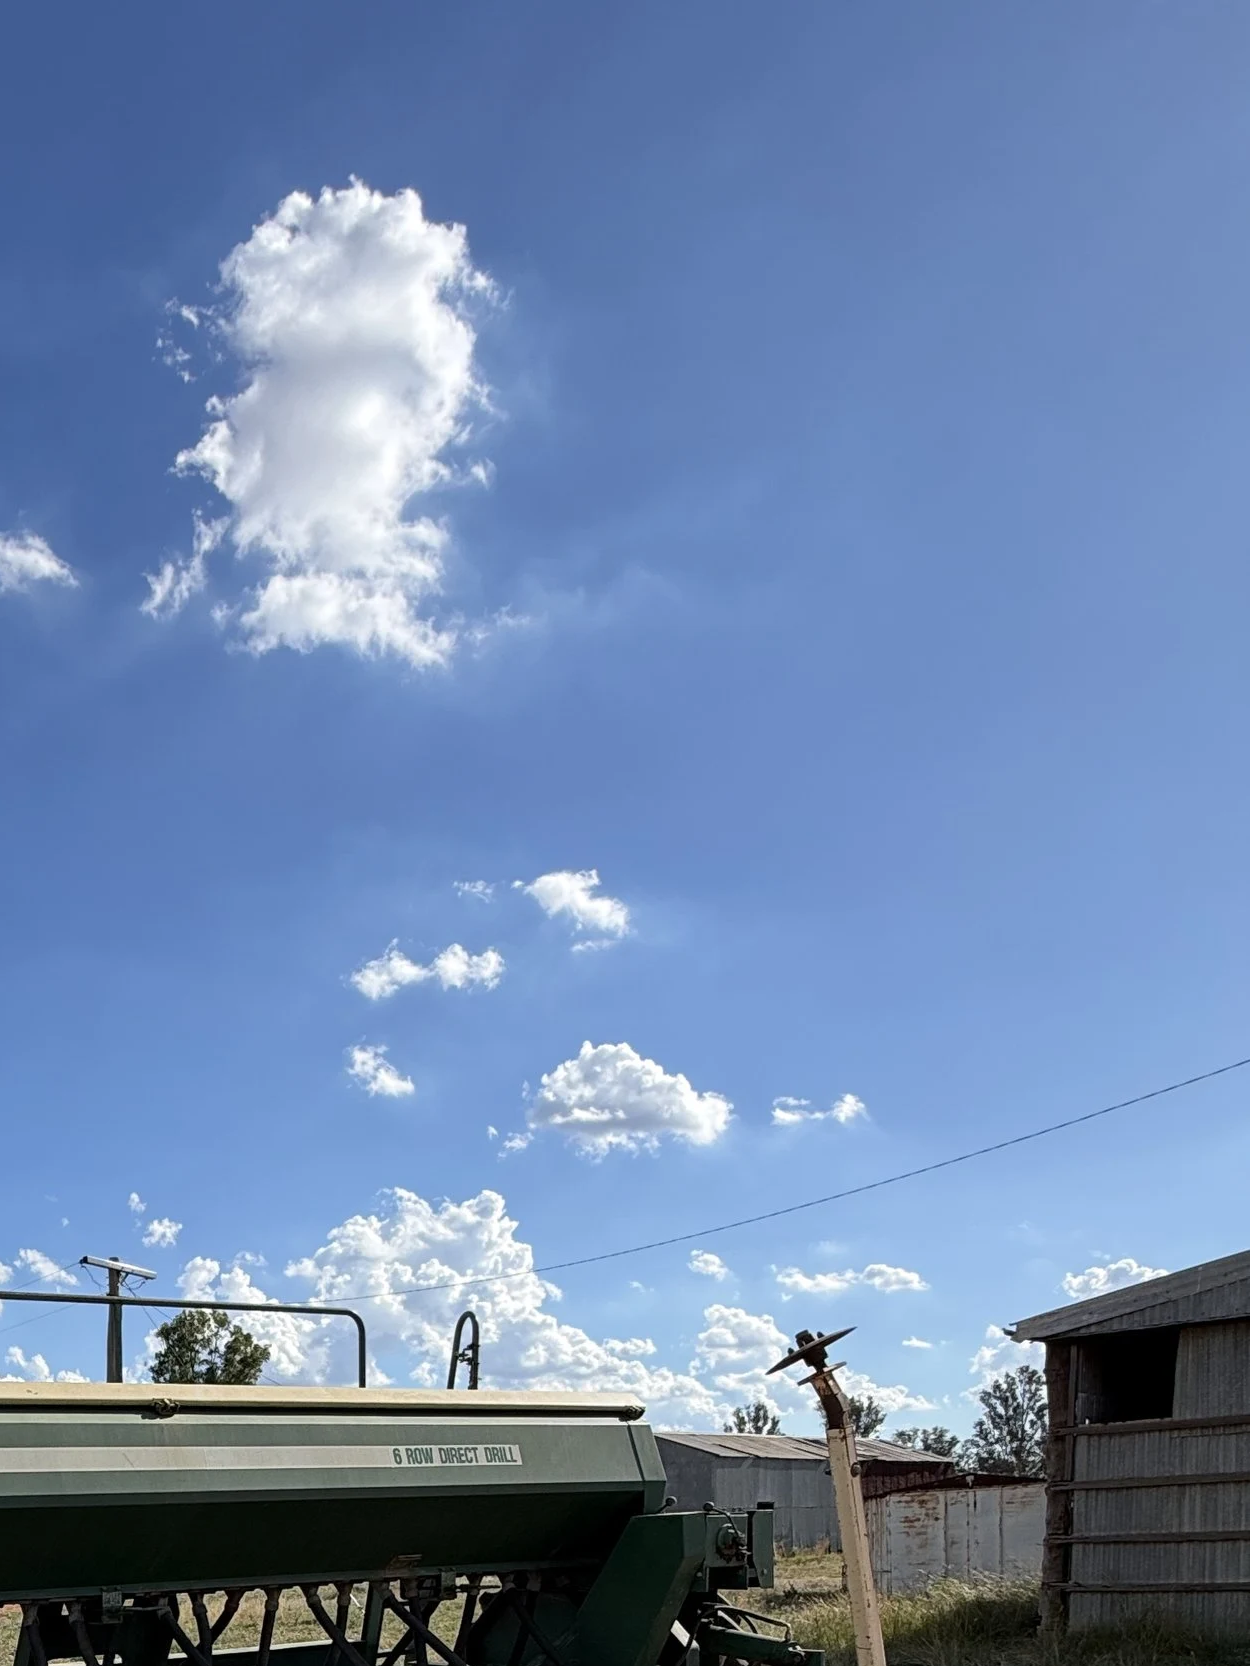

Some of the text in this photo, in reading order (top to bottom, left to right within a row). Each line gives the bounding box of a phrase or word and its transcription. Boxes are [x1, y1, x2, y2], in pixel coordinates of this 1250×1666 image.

[392, 1446, 518, 1465] 6 ROW DIRECT DRILL
